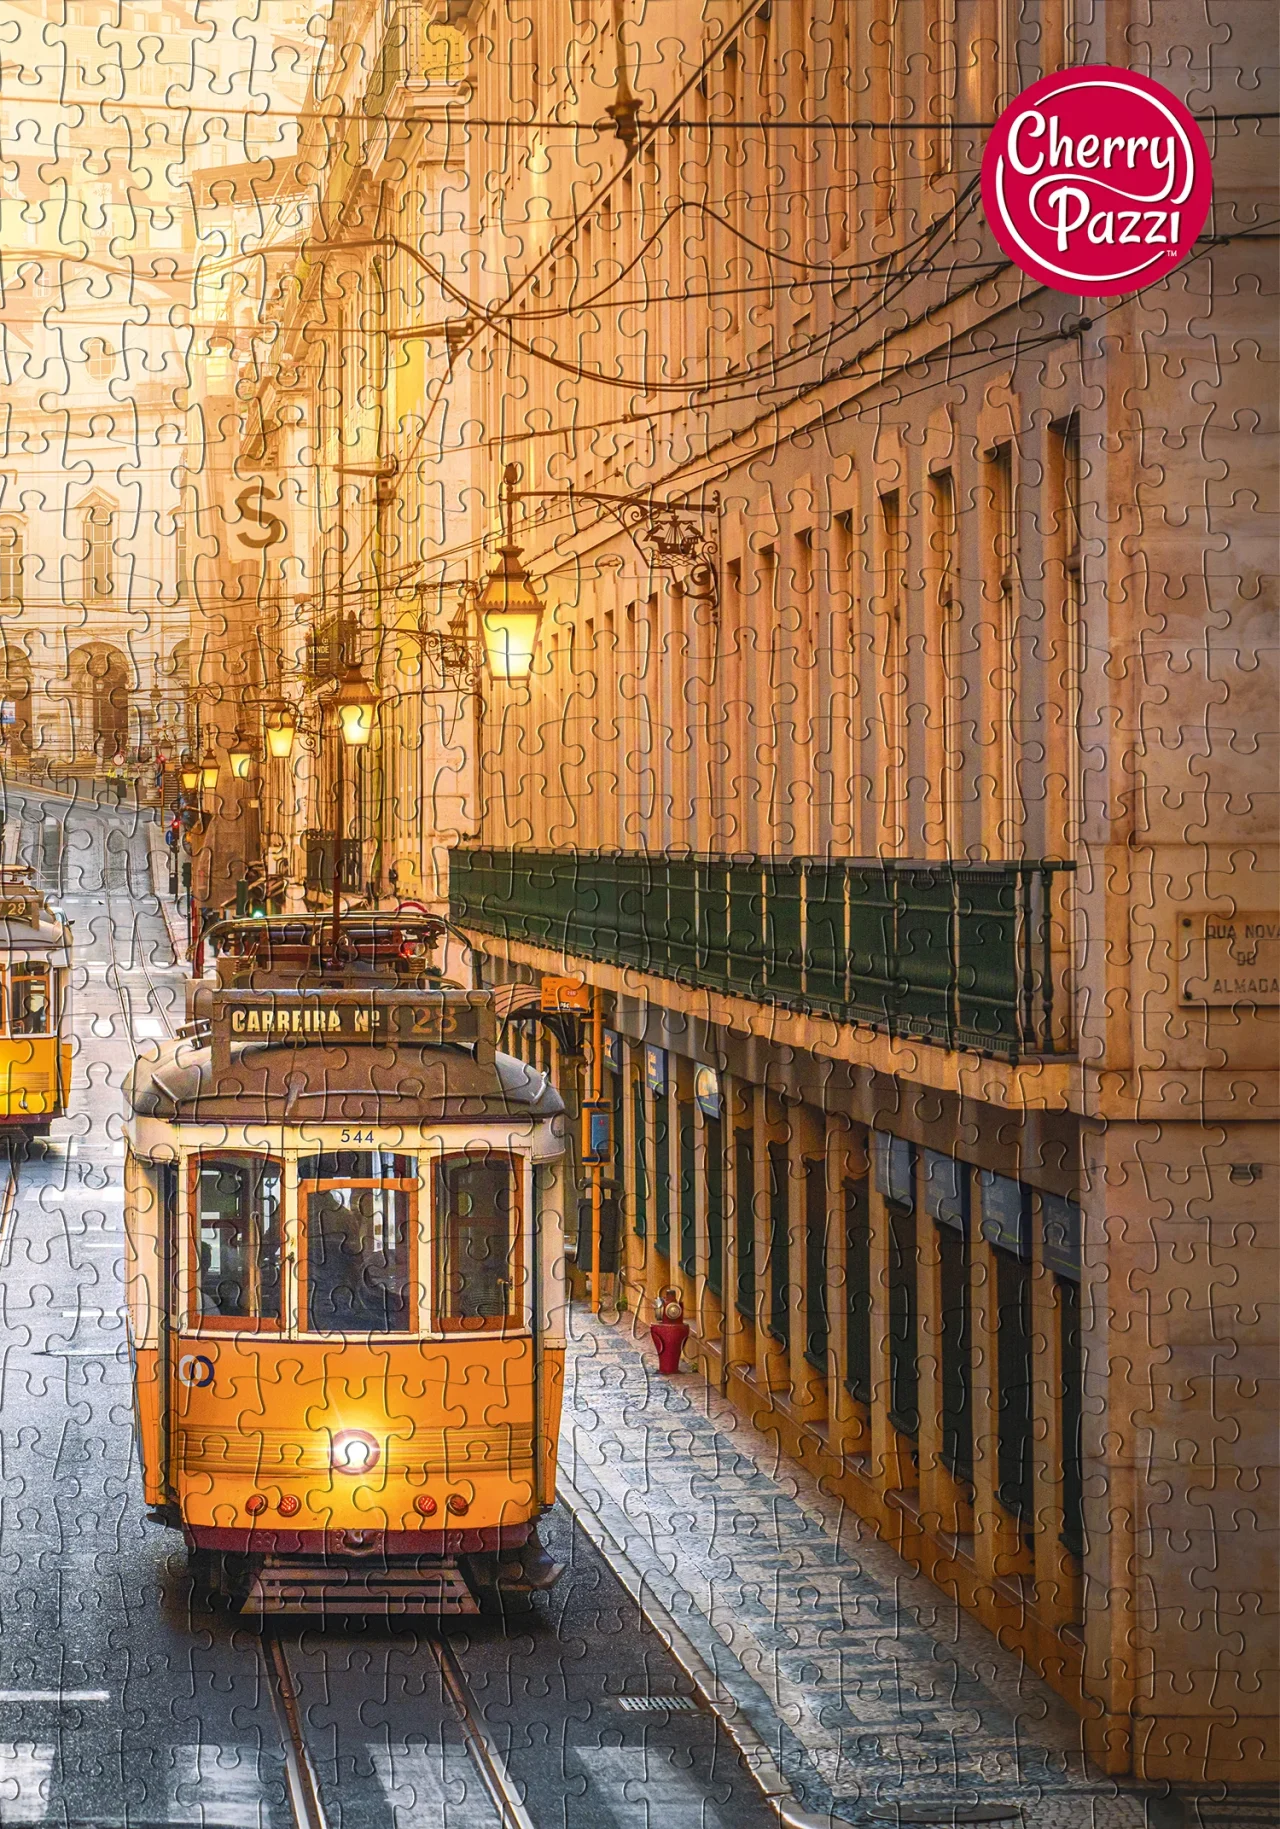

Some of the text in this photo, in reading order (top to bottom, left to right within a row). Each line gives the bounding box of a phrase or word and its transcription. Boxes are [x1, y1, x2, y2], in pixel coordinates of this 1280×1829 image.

[235, 487, 280, 549] S
[8, 902, 25, 915] 28
[231, 1010, 341, 1033] CARREIRA
[411, 1006, 458, 1034] 28
[340, 1129, 374, 1144] 544
